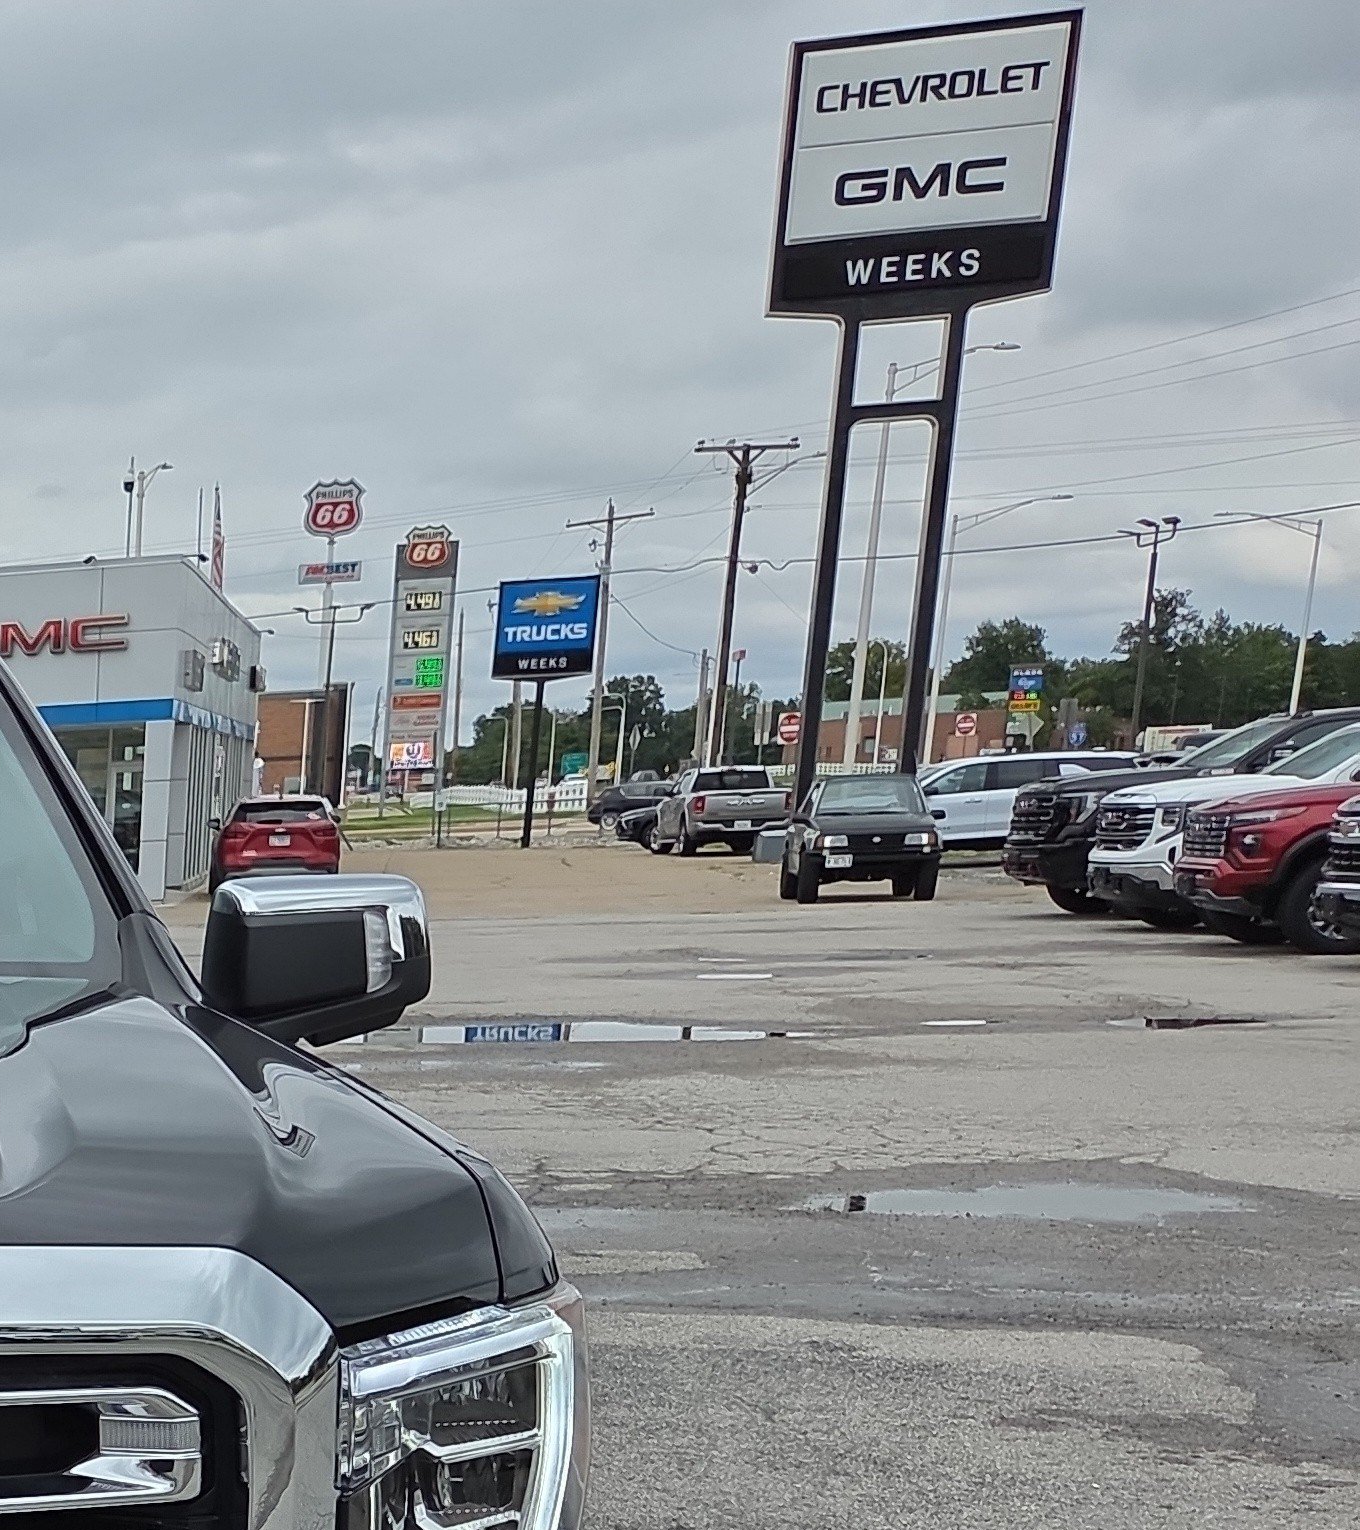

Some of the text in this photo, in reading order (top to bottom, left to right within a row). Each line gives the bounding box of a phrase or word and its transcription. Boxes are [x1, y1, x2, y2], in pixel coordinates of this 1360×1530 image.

[816, 61, 1051, 114] CHEVROLET
[834, 156, 1008, 206] GMC
[846, 248, 981, 286] WEEKS
[316, 488, 354, 499] PHILLIPS
[315, 503, 351, 525] 66
[412, 531, 445, 541] PHILLIPS
[412, 543, 443, 562] 66
[503, 623, 588, 643] TRUCKS
[518, 656, 568, 670] WEEKS
